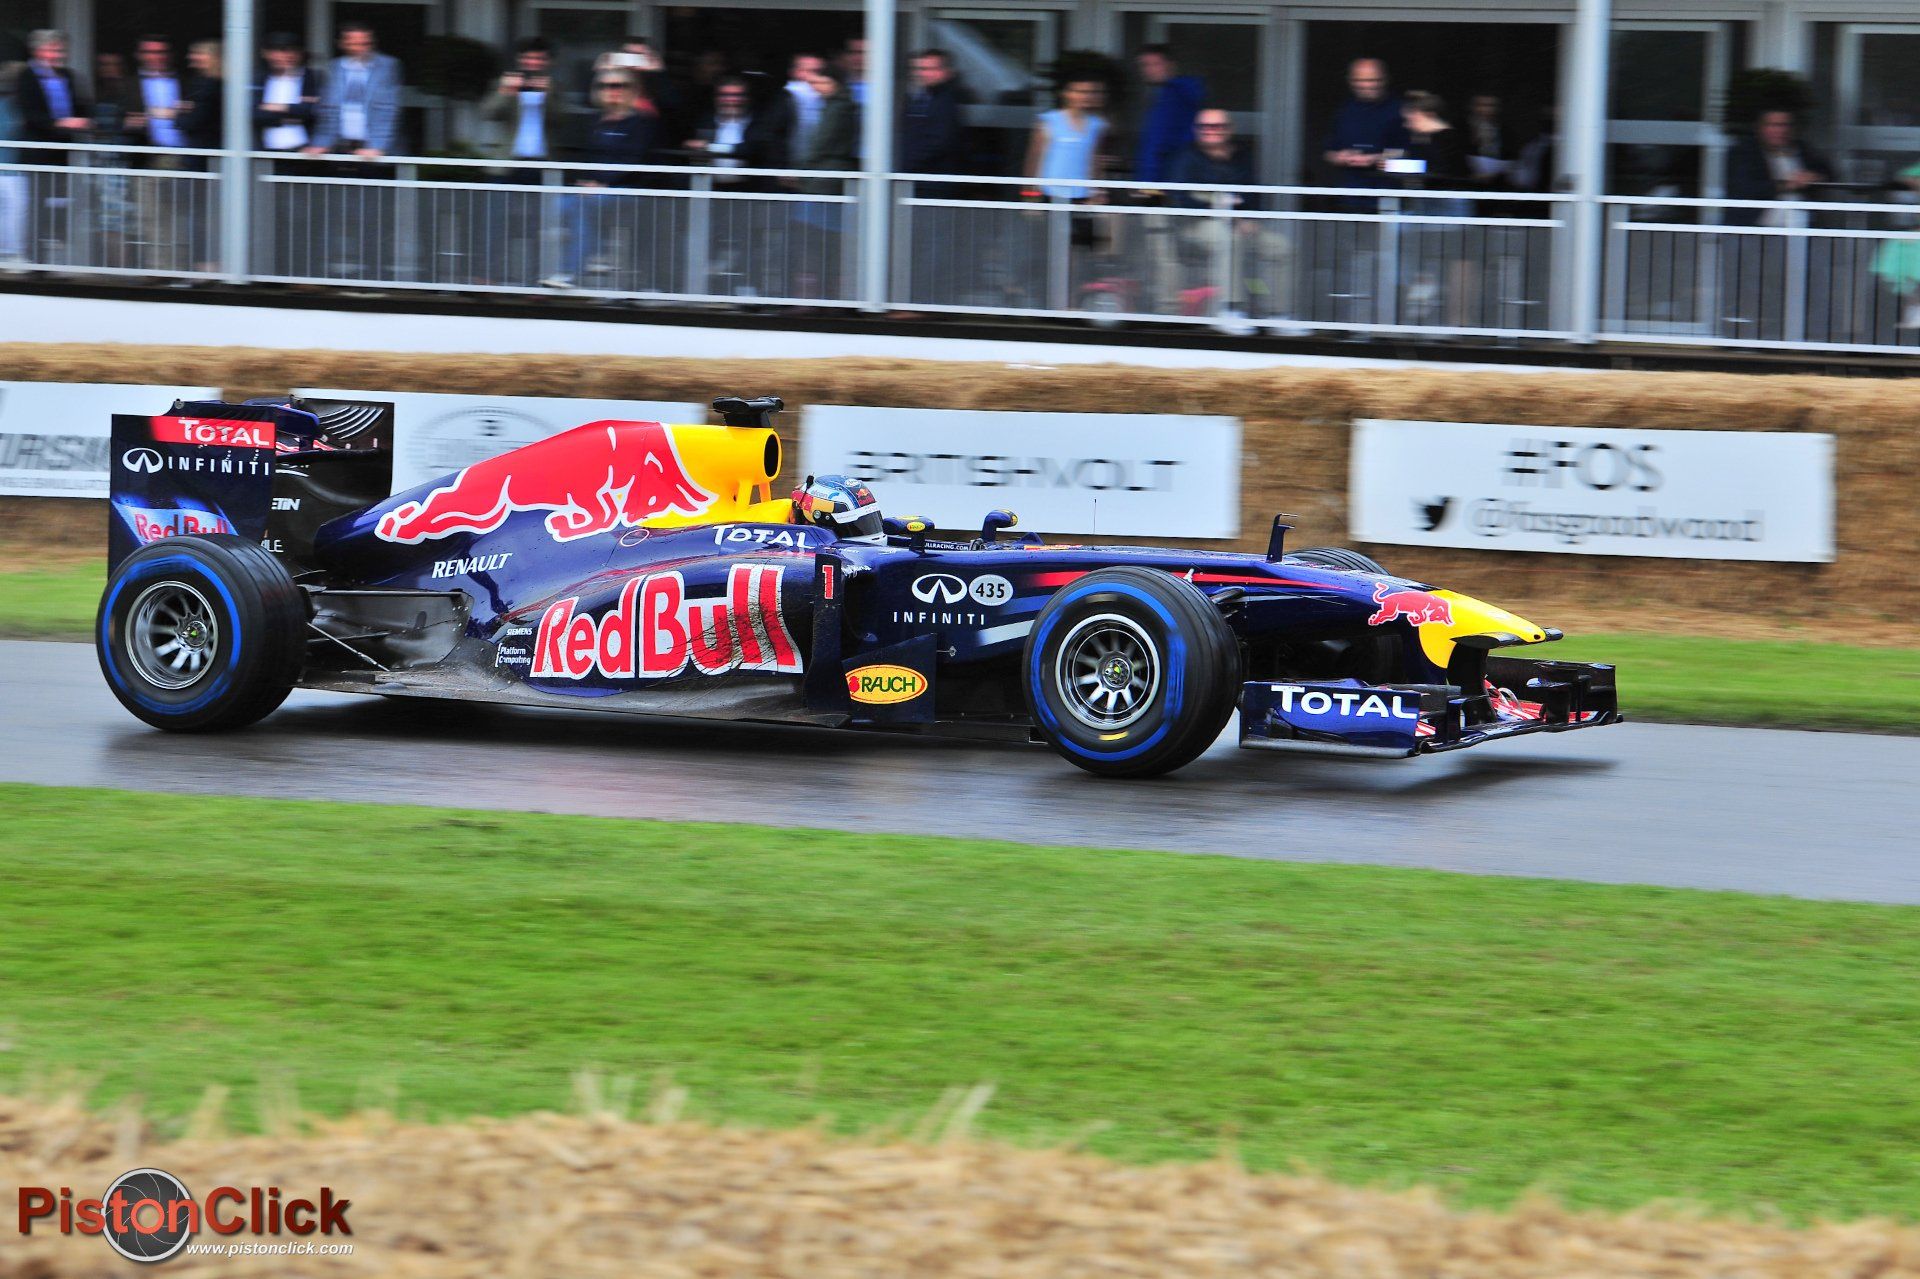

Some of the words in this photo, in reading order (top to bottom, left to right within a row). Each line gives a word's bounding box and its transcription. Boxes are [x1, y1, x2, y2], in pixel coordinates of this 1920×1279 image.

[178, 417, 270, 446] TOTAL
[168, 456, 270, 476] INFINITI
[1502, 438, 1665, 492] #FOS
[712, 524, 816, 549] TOTAL
[431, 553, 513, 578] RENAULT
[821, 564, 834, 600] 1
[975, 583, 1005, 600] 435
[529, 574, 648, 680] Red
[638, 563, 804, 678] Bull
[893, 611, 985, 626] INFINITI
[500, 646, 526, 655] Platform
[861, 676, 916, 693] RAUCH
[1271, 685, 1418, 720] TOTAL
